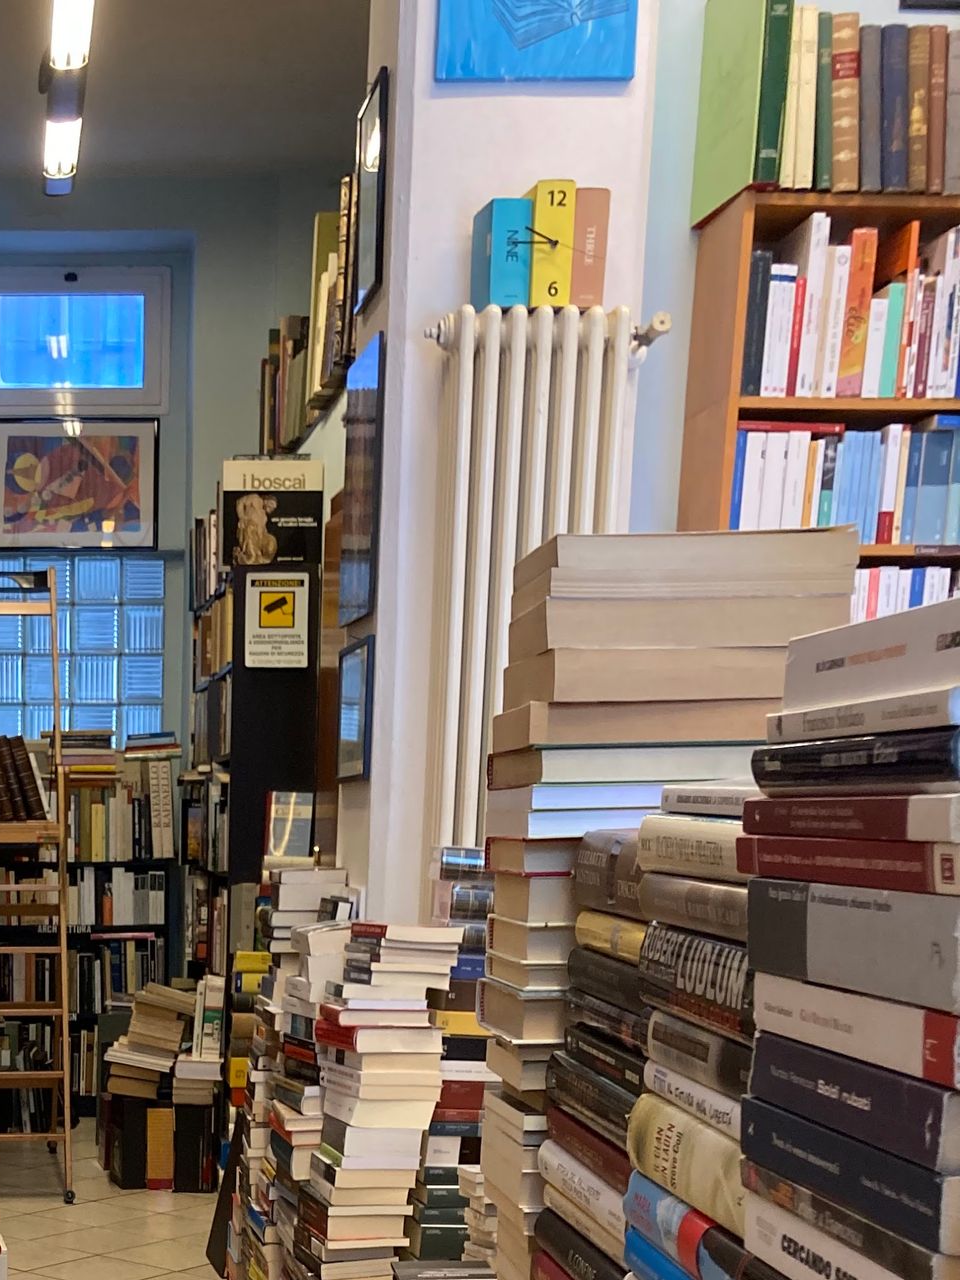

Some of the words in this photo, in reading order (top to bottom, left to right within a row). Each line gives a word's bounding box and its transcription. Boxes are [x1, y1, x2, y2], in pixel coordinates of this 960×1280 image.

[548, 190, 567, 207] 12
[506, 229, 519, 263] NINE
[584, 226, 596, 266] THREE
[548, 281, 558, 297] 6
[242, 474, 246, 490] i
[151, 765, 160, 829] RAFFAELLO
[162, 764, 171, 829] RAFFAELLO
[643, 926, 687, 967] ROBERT
[676, 936, 749, 1011] LUDLUM
[655, 1126, 665, 1160] CLAN
[663, 1122, 676, 1163] LADEN
[670, 1157, 679, 1190] Steve
[781, 1233, 832, 1280] CERCANDO
